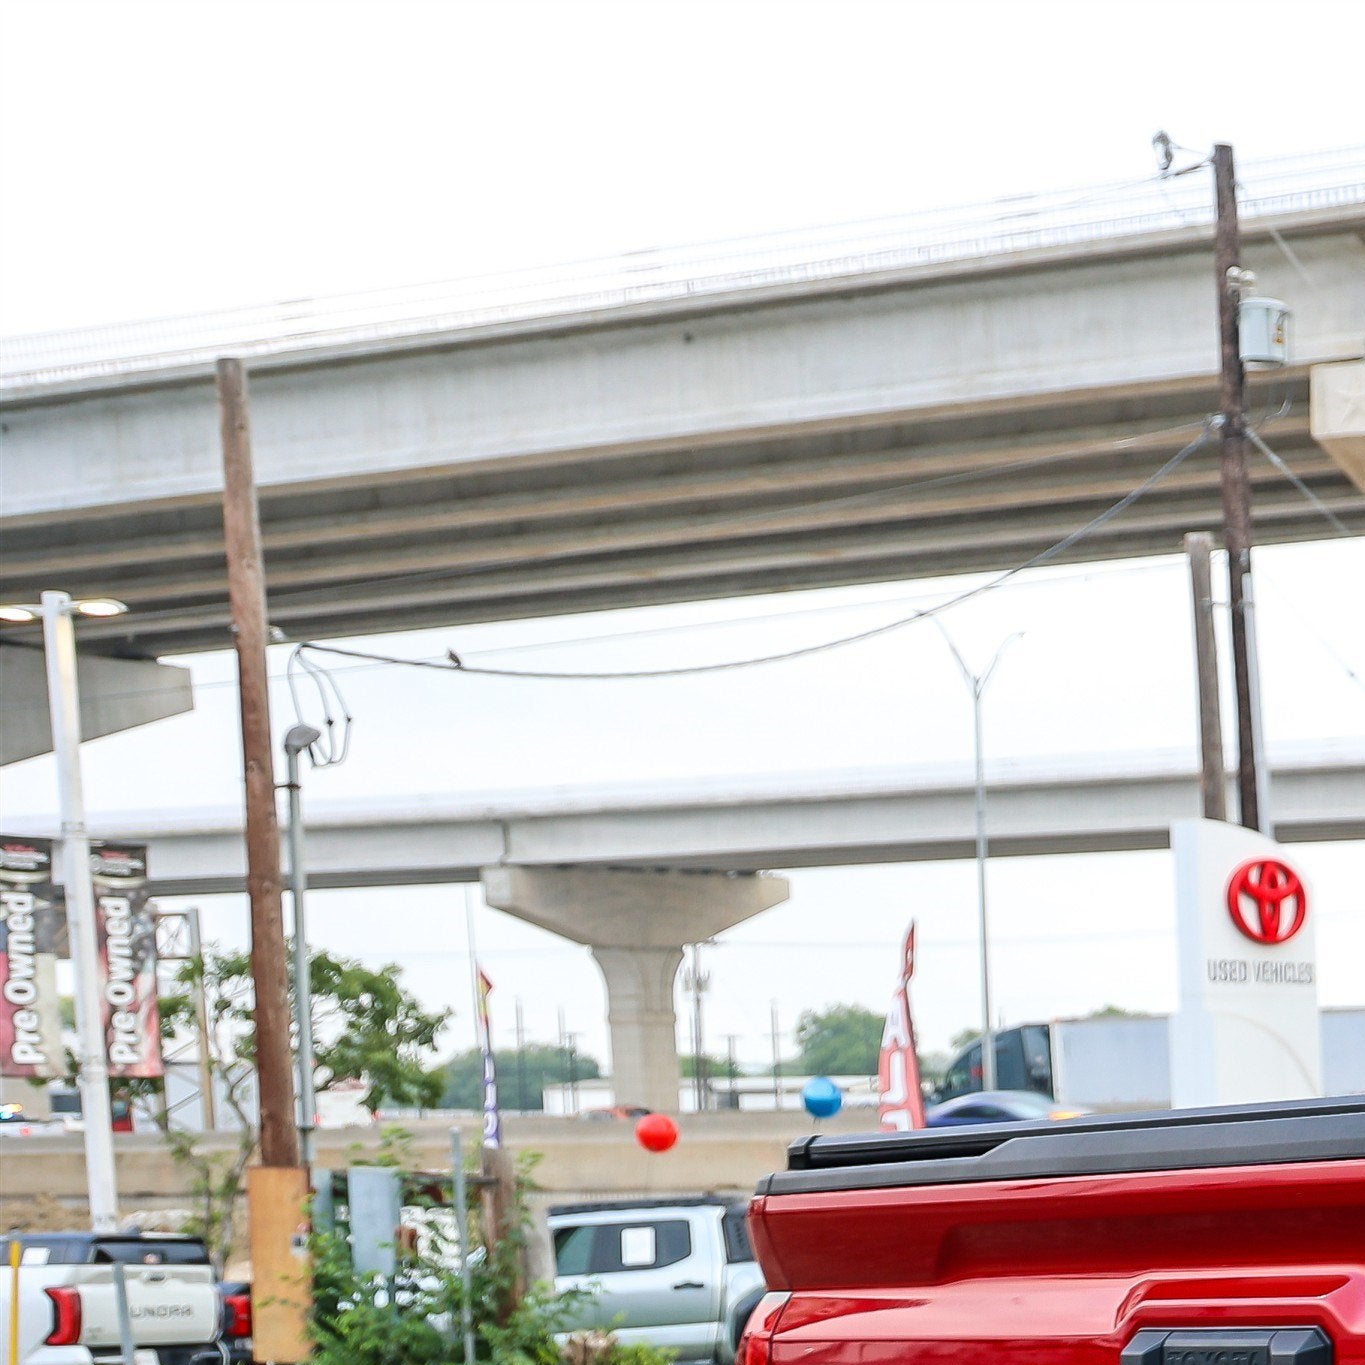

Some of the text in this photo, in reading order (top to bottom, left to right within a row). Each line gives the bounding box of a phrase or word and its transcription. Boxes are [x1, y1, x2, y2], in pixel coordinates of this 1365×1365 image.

[0, 892, 37, 1006] Owned
[99, 896, 136, 1006] Owned
[1207, 959, 1314, 984] USED VEHICLES
[10, 1010, 48, 1065] Pre
[109, 1011, 142, 1065] Pre
[128, 1304, 194, 1318] UNDRA
